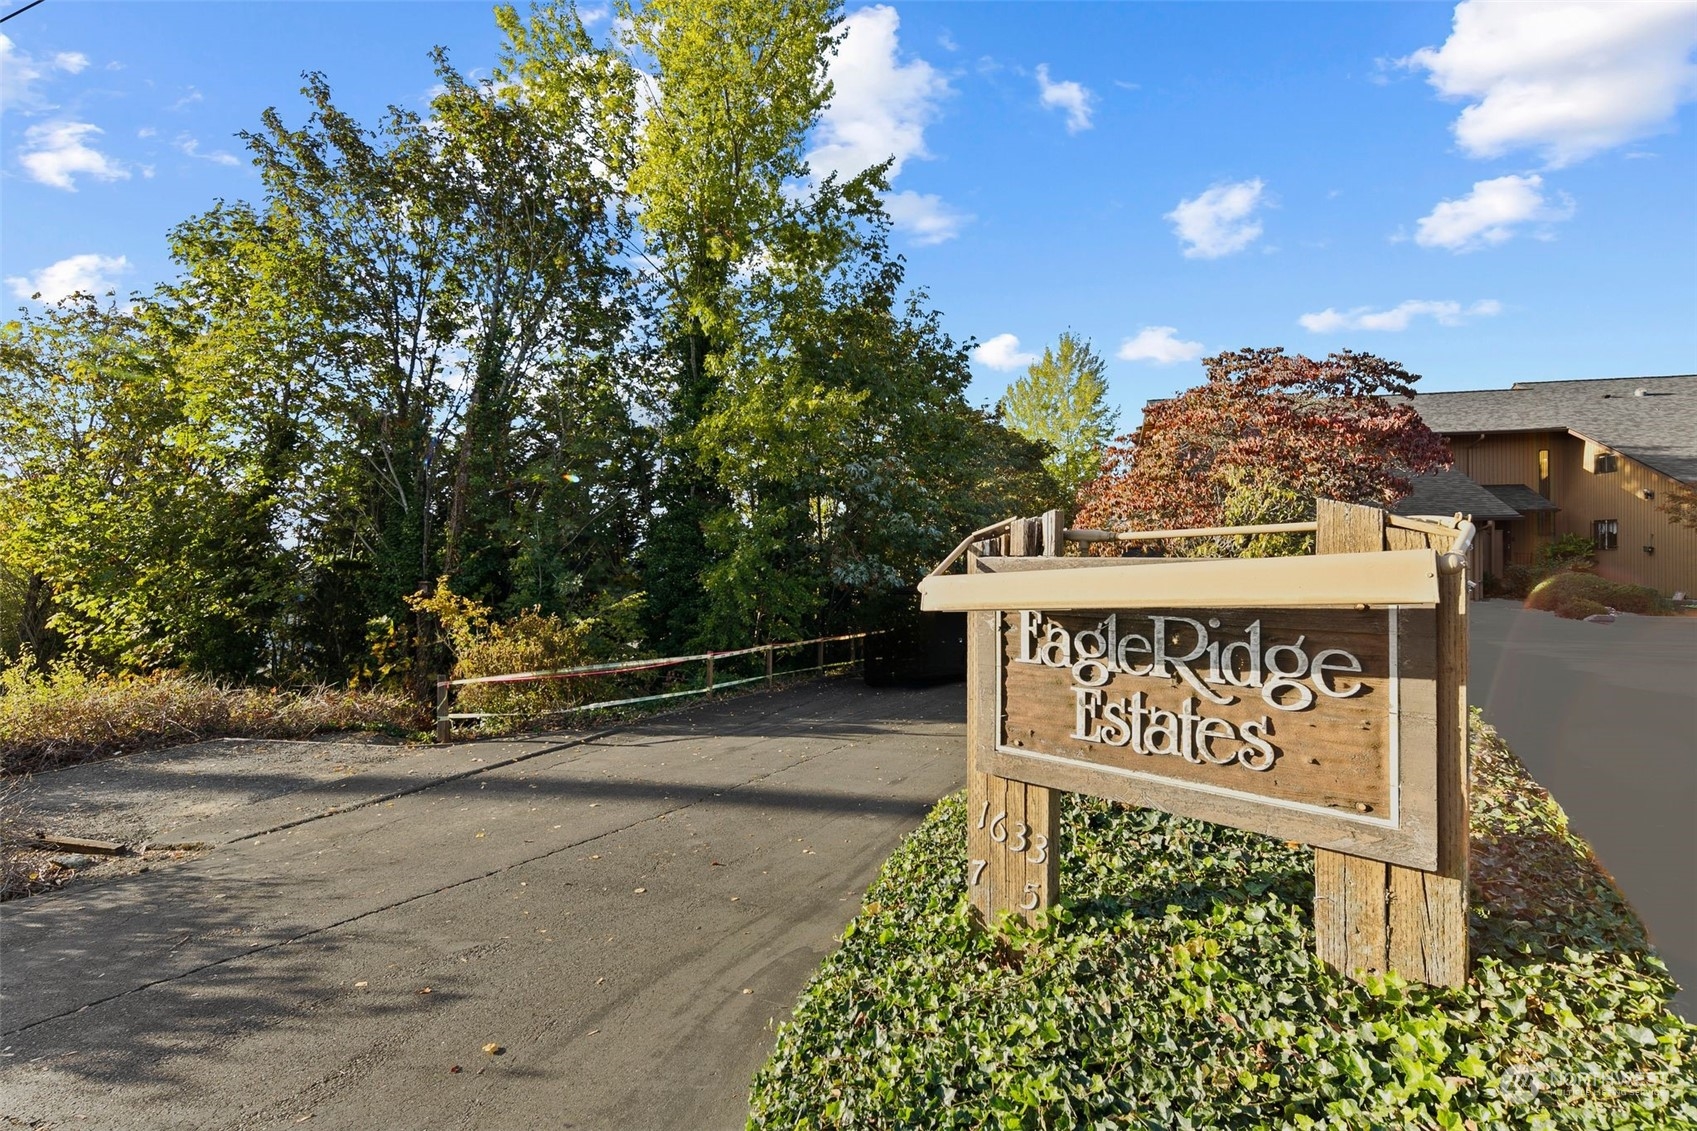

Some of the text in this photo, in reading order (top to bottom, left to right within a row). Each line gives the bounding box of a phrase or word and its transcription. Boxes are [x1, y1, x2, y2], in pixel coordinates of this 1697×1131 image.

[1015, 609, 1362, 712] EagleRidge
[1070, 686, 1276, 772] Estates
[977, 800, 1049, 864] 1633
